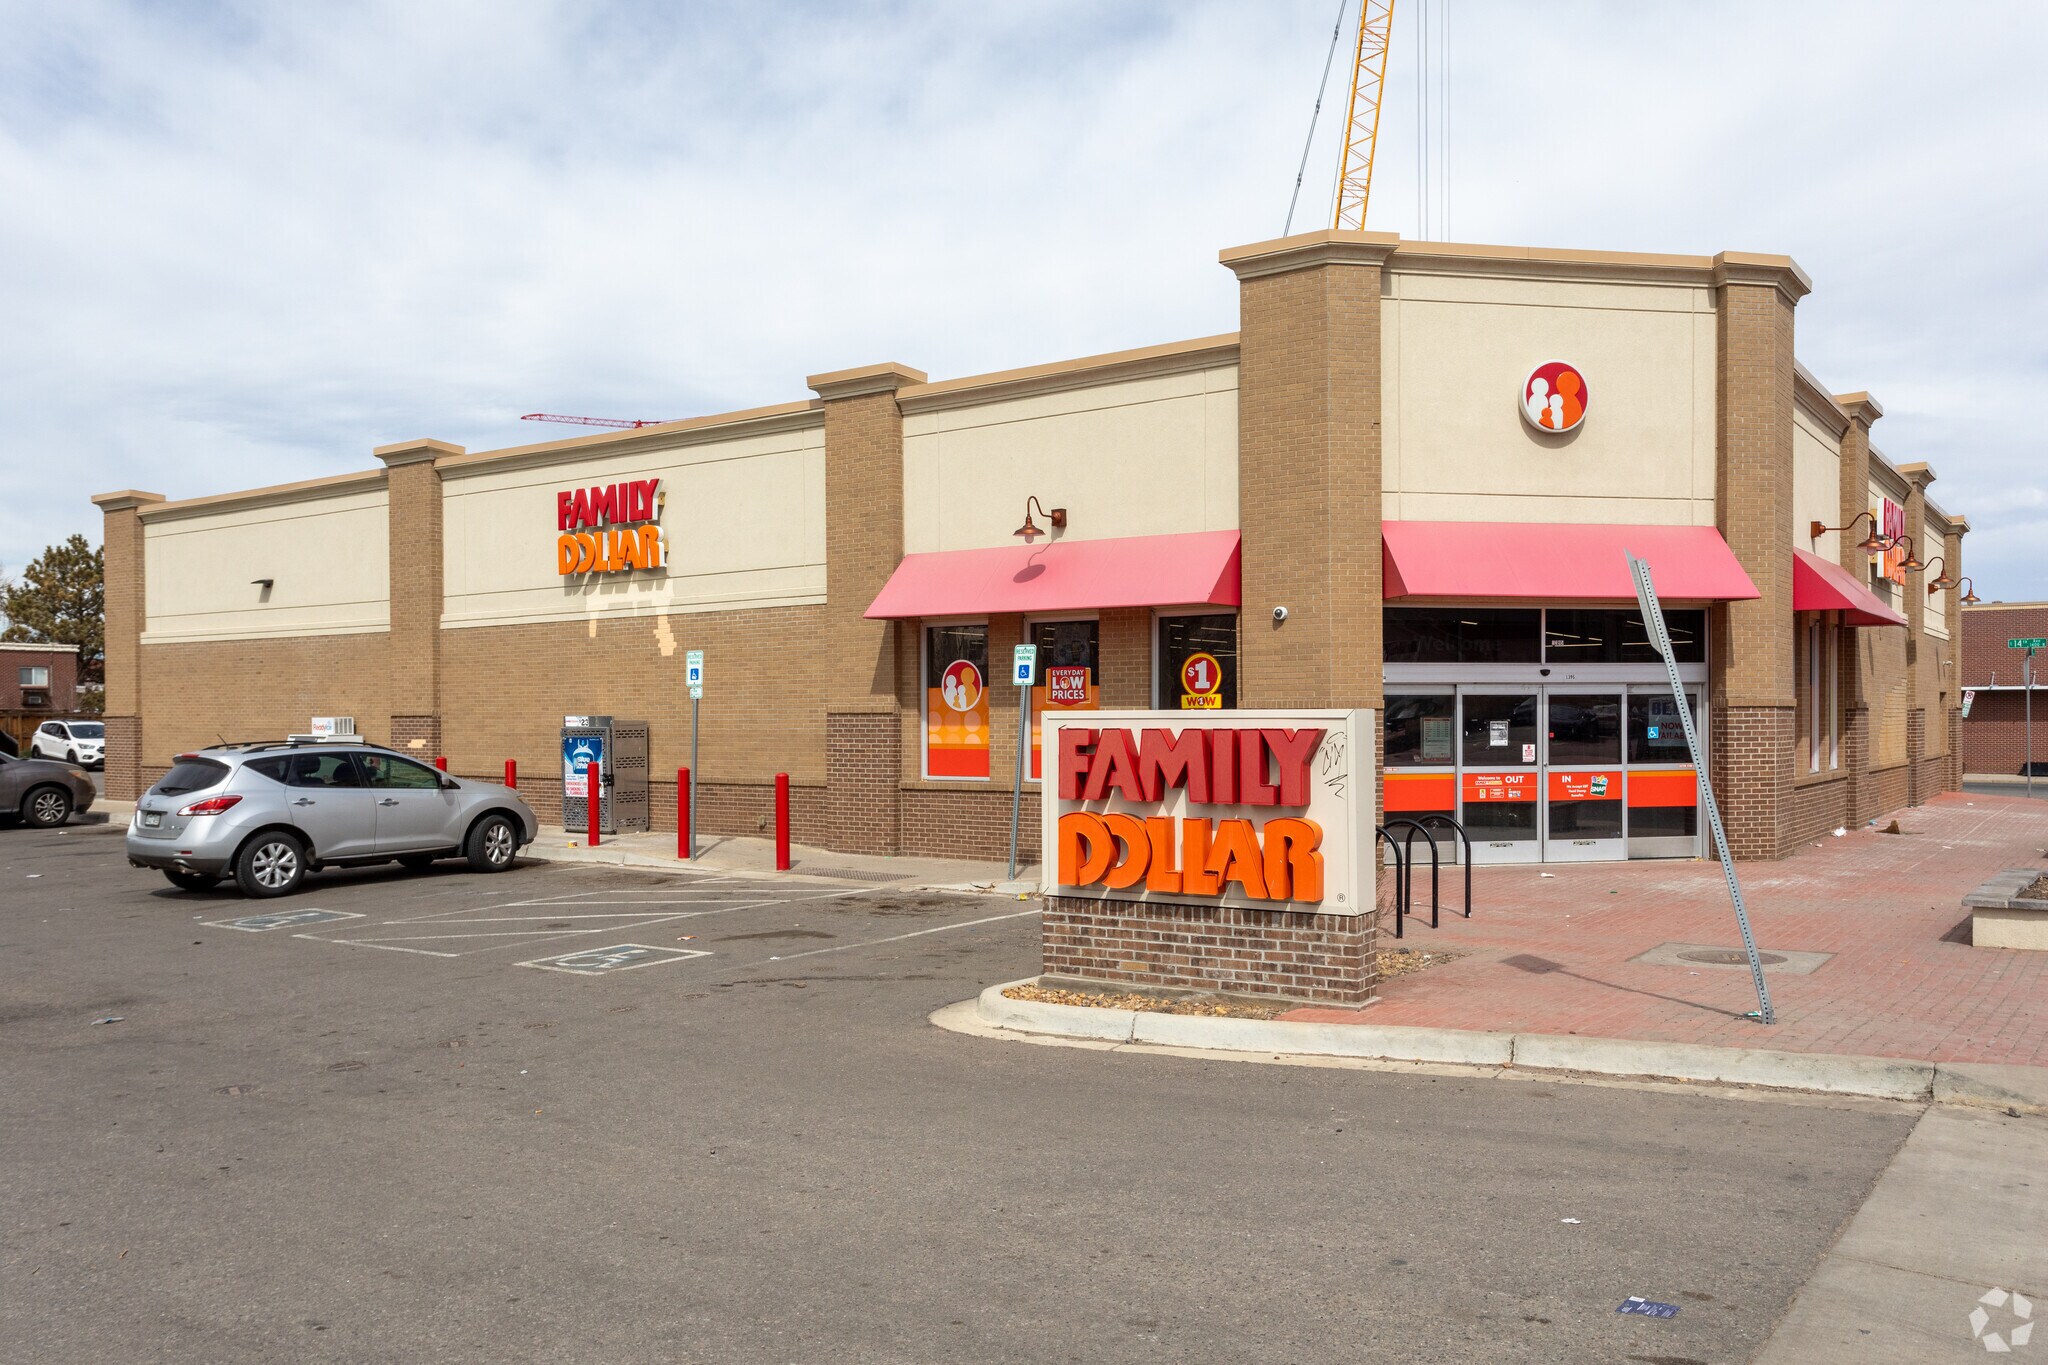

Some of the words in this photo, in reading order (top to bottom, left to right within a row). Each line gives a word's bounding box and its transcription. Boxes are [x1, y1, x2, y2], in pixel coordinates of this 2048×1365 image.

[558, 479, 661, 531] FAMILY
[558, 524, 662, 575] DOLLAR
[1052, 676, 1084, 689] LOW
[1187, 660, 1210, 689] $1
[1052, 689, 1084, 700] PRICES
[1058, 728, 1325, 806] FAMILY
[1505, 775, 1524, 784] OUT
[1561, 775, 1571, 783] IN
[1058, 811, 1324, 904] DOLLAR
